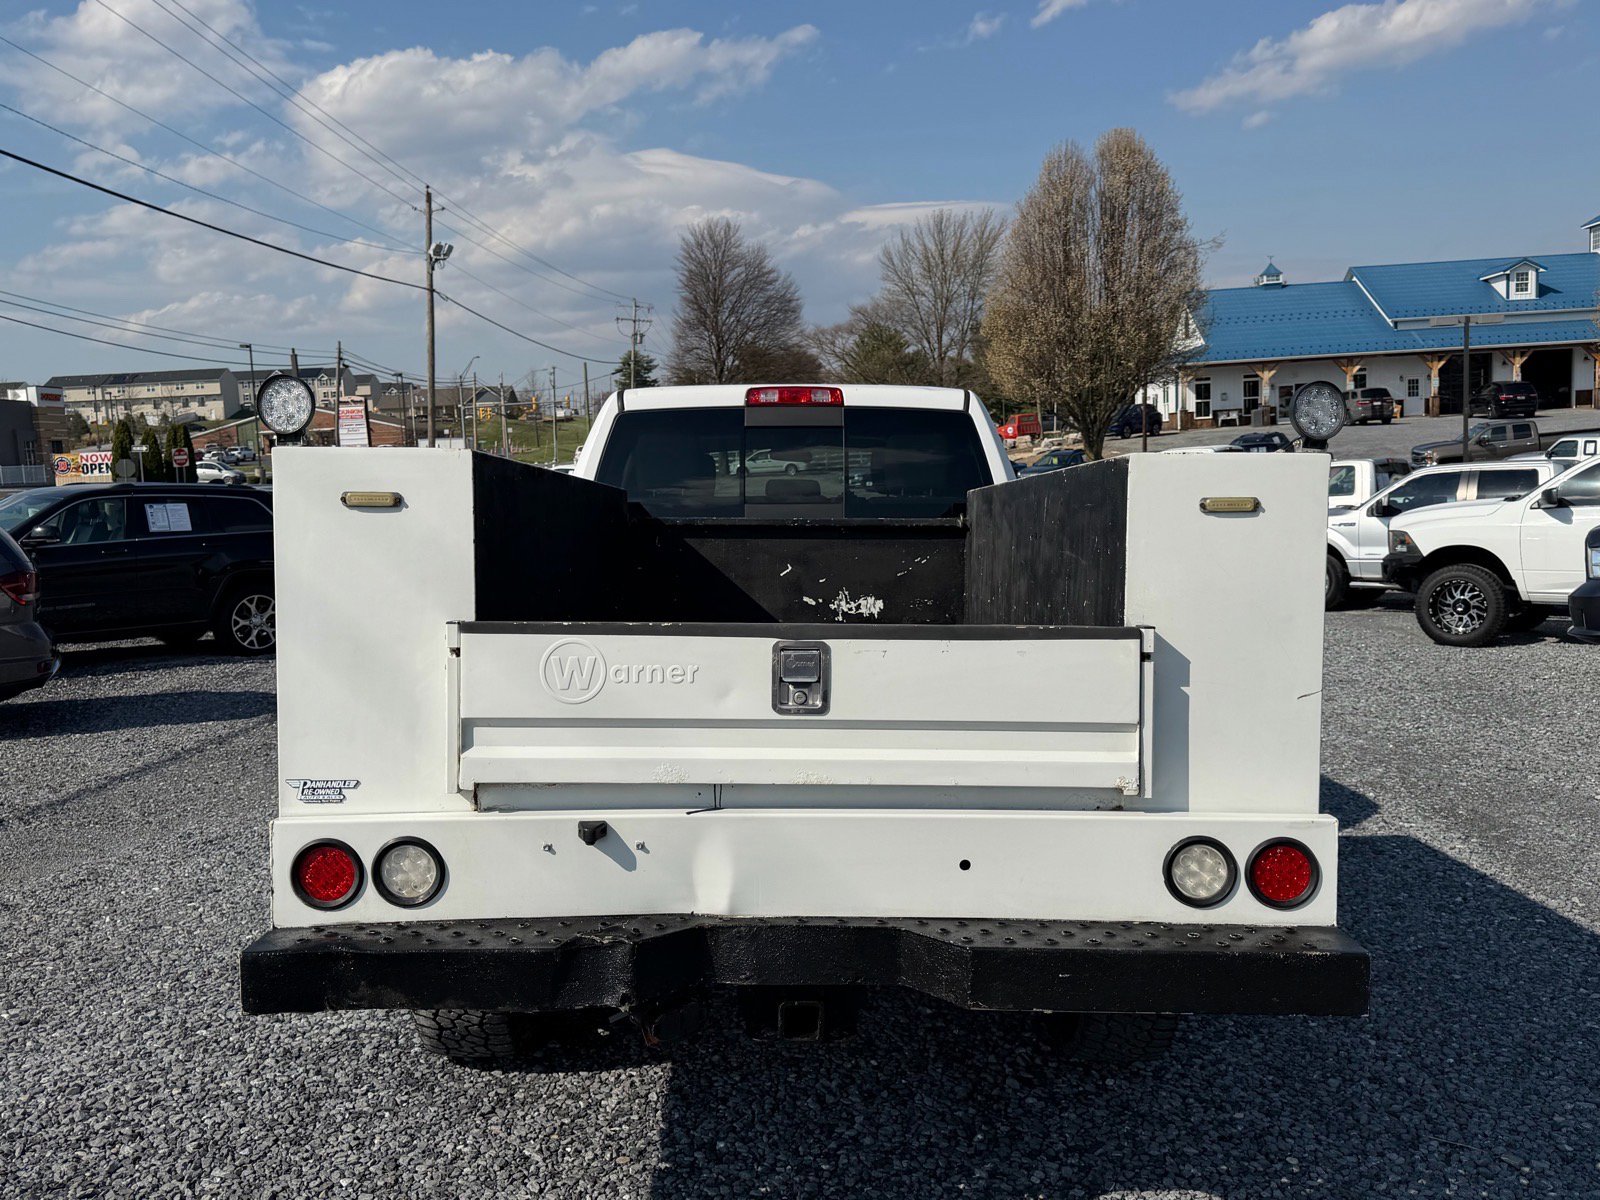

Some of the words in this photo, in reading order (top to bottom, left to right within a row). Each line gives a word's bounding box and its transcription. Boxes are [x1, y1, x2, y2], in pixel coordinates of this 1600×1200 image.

[80, 454, 112, 463] NOW
[81, 463, 111, 474] OPEN
[547, 653, 700, 692] Warner
